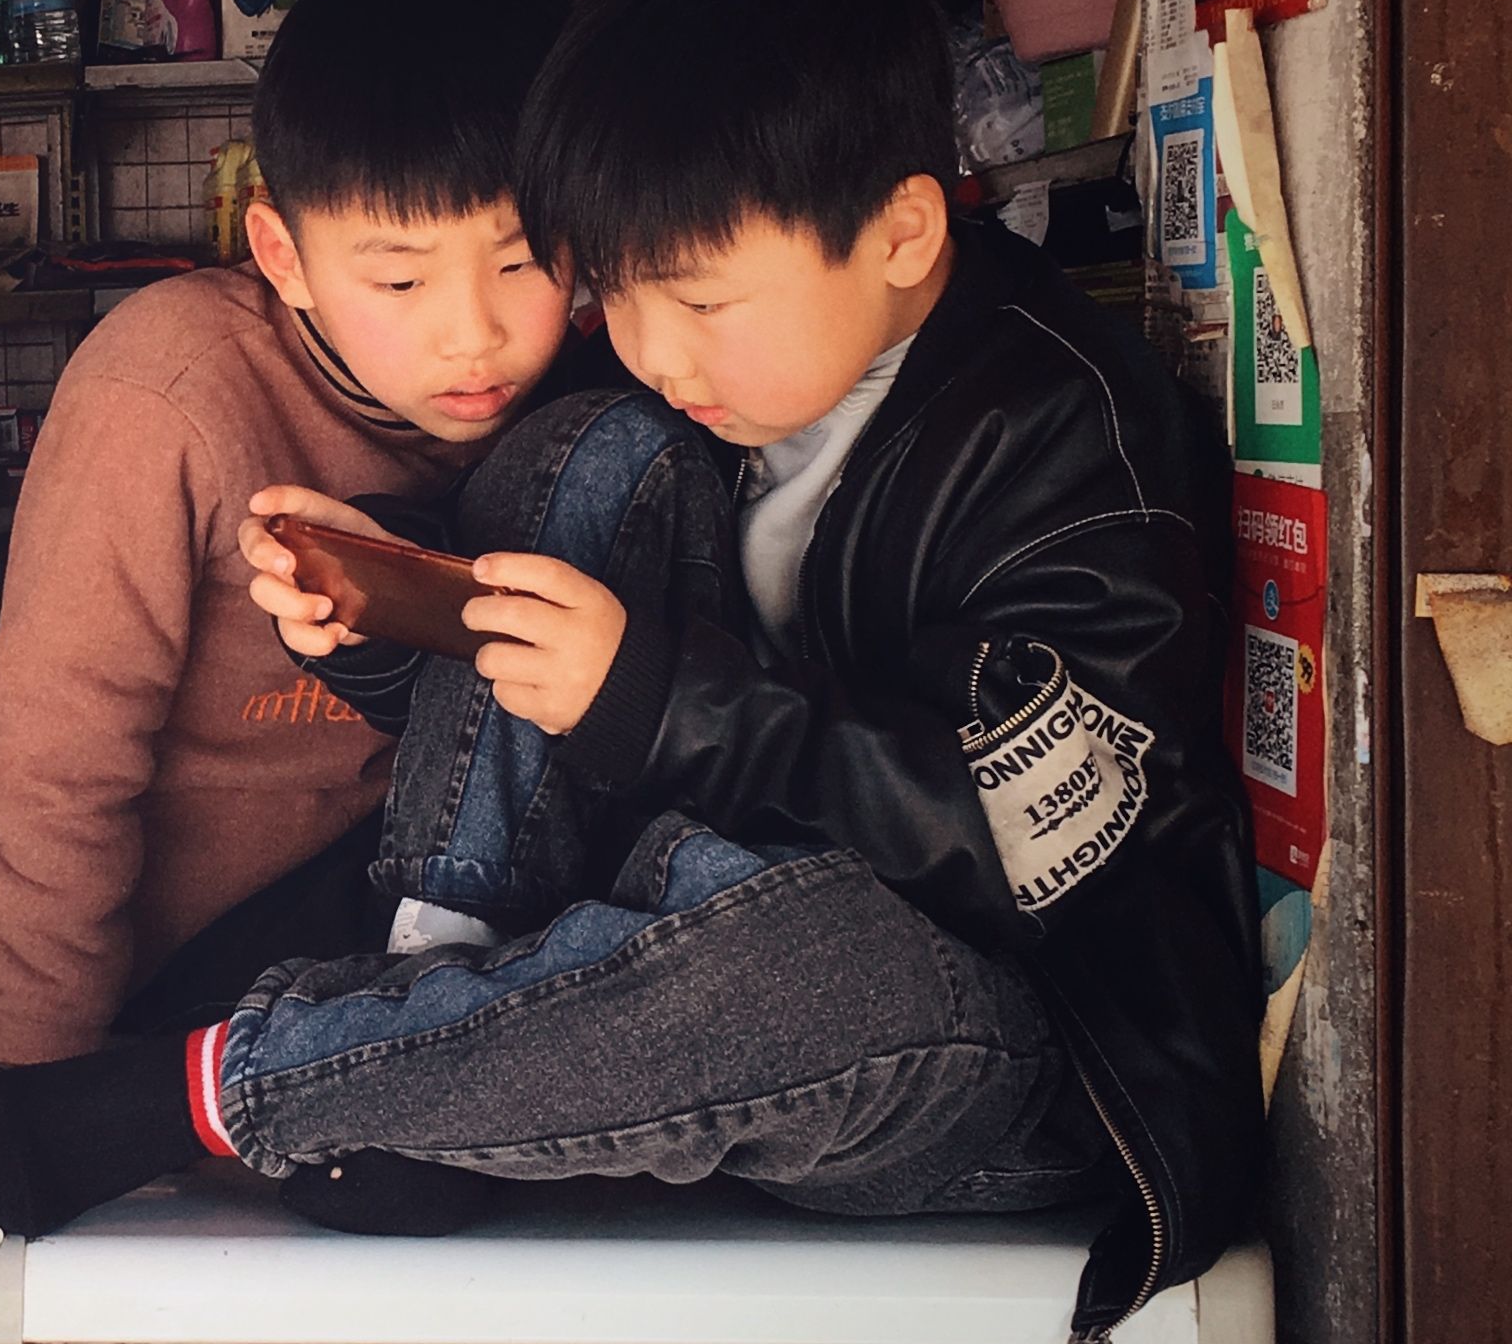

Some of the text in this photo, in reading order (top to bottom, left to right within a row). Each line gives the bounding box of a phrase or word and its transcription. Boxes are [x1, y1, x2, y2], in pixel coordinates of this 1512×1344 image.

[1238, 506, 1308, 555] 扫码领红包
